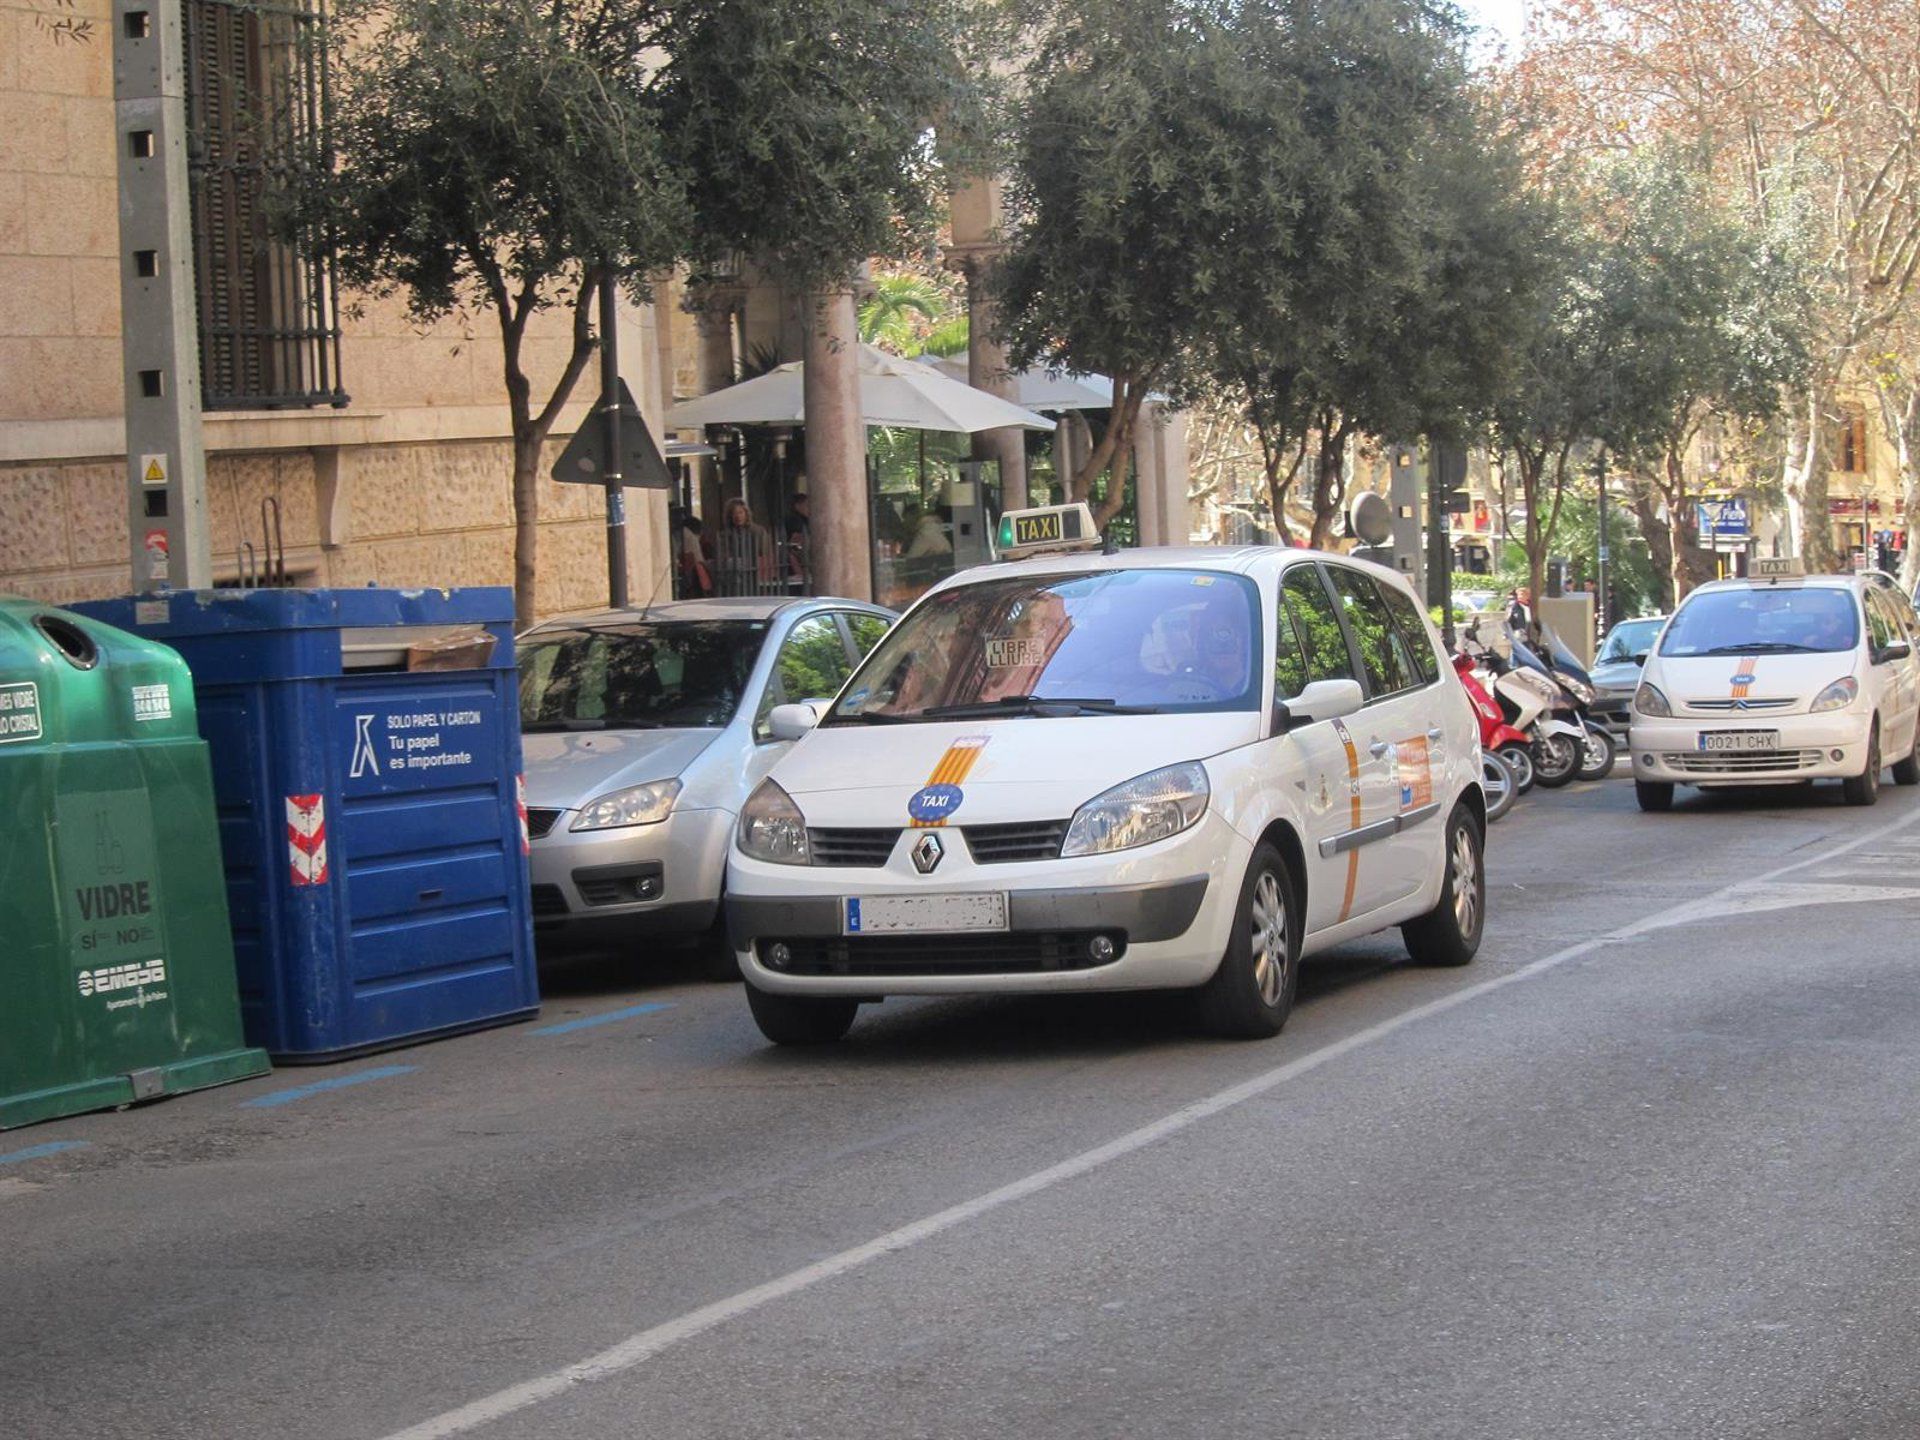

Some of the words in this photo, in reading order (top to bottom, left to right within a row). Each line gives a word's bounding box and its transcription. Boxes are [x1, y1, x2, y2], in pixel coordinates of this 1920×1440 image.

[1018, 516, 1058, 540] TAXI
[1761, 561, 1790, 575] TAXI
[992, 640, 1038, 655] LIBRE
[990, 652, 1042, 667] LLIURE
[387, 714, 411, 729] SOLO
[412, 713, 439, 727] PAPEL
[440, 712, 447, 726] Y
[388, 735, 404, 750] Tu
[407, 733, 440, 752] papel
[1707, 736, 1740, 749] 0021
[1747, 734, 1775, 750] CHX
[389, 757, 405, 769] es
[408, 751, 472, 770] importante
[922, 794, 950, 807] TAXI
[76, 881, 151, 921] VIDRE
[116, 928, 140, 946] NO
